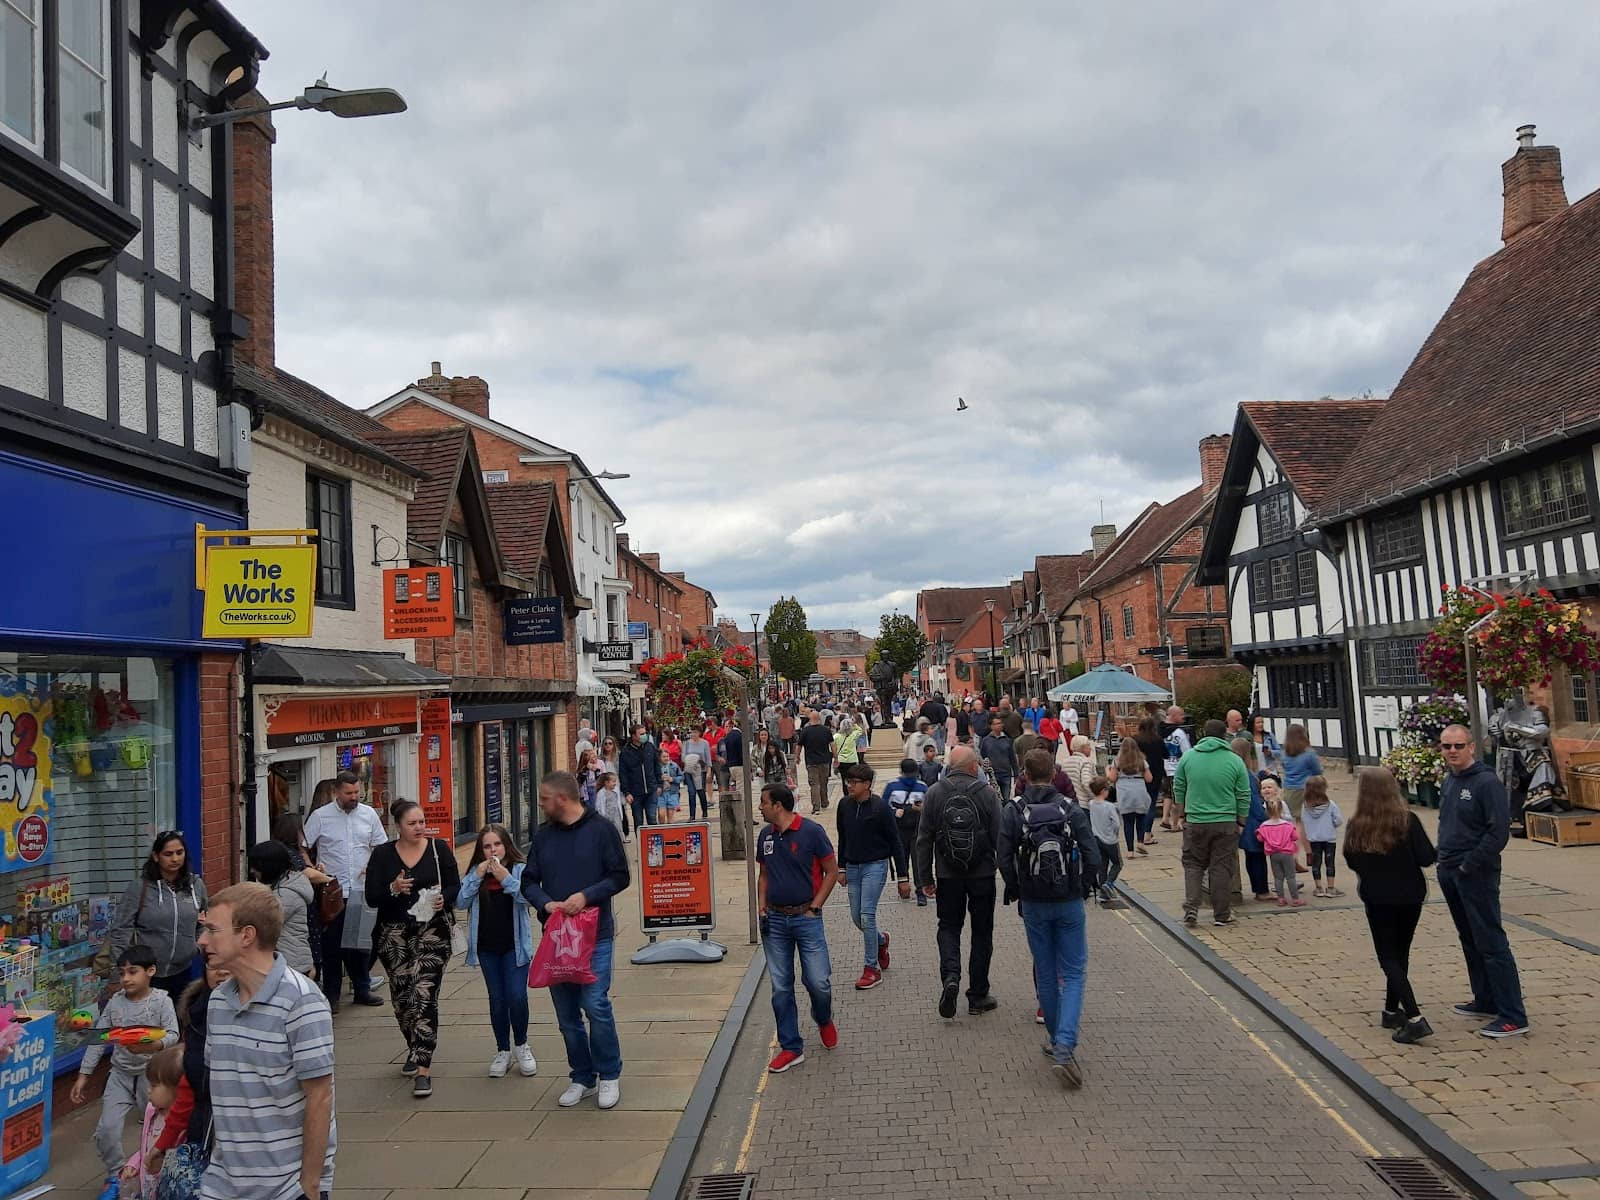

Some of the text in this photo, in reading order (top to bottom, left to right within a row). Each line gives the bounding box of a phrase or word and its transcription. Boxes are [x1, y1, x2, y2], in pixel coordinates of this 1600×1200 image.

[241, 430, 246, 440] 5
[240, 558, 282, 580] The
[223, 583, 295, 604] Works
[394, 606, 438, 614] UNLOCKING
[531, 604, 556, 613] Clarke
[223, 612, 292, 622] TheWorks.co.uk
[394, 616, 447, 624] ACCESSORIES
[601, 645, 629, 653] ANTIQUE
[602, 651, 629, 659] CENTRE
[1073, 694, 1096, 702] CREAM
[308, 703, 348, 725] PHONE
[350, 700, 371, 722] BITS
[374, 701, 380, 719] 4
[299, 733, 325, 743] UNLOCKING
[26, 823, 41, 832] Huge
[23, 832, 42, 843] Range
[13, 1036, 45, 1063] Kids
[0, 1055, 51, 1090] Fun For
[7, 1074, 45, 1108] Less!
[10, 1123, 40, 1150] £1.50
